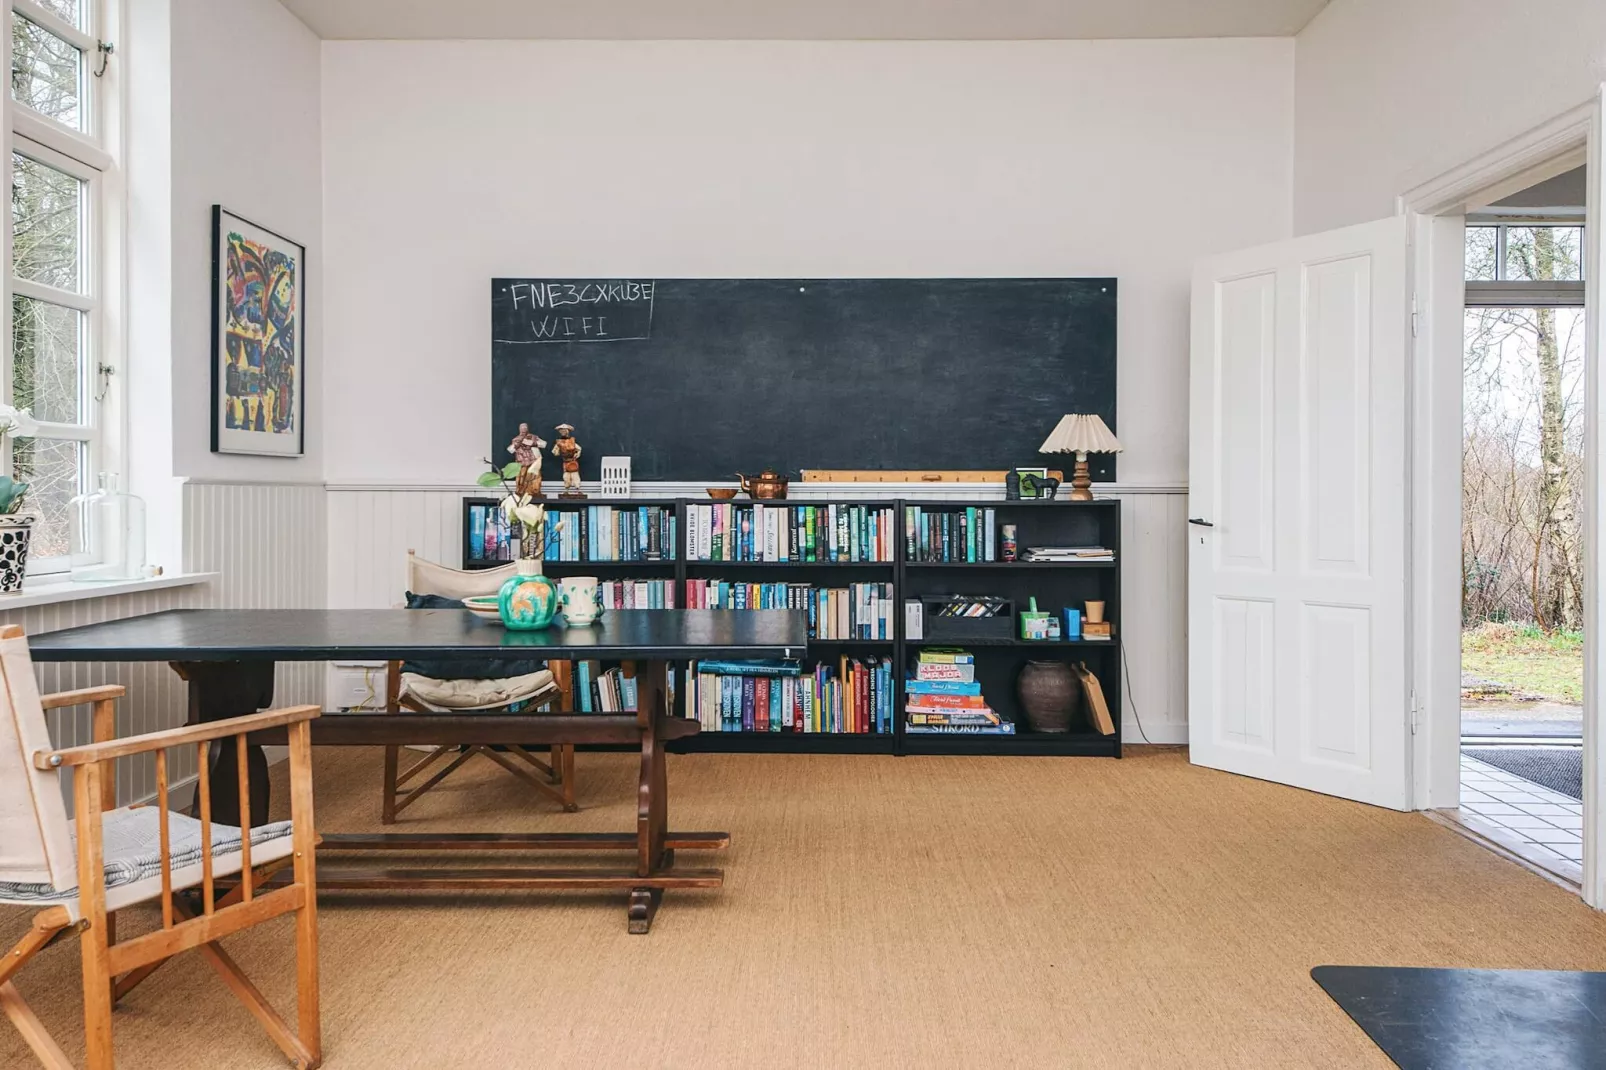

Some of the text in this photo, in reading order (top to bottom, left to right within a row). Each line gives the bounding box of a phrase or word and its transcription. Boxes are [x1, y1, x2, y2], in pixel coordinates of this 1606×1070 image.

[531, 315, 608, 338] WIFI
[920, 664, 957, 673] KLODS
[923, 671, 961, 679] MAJOR
